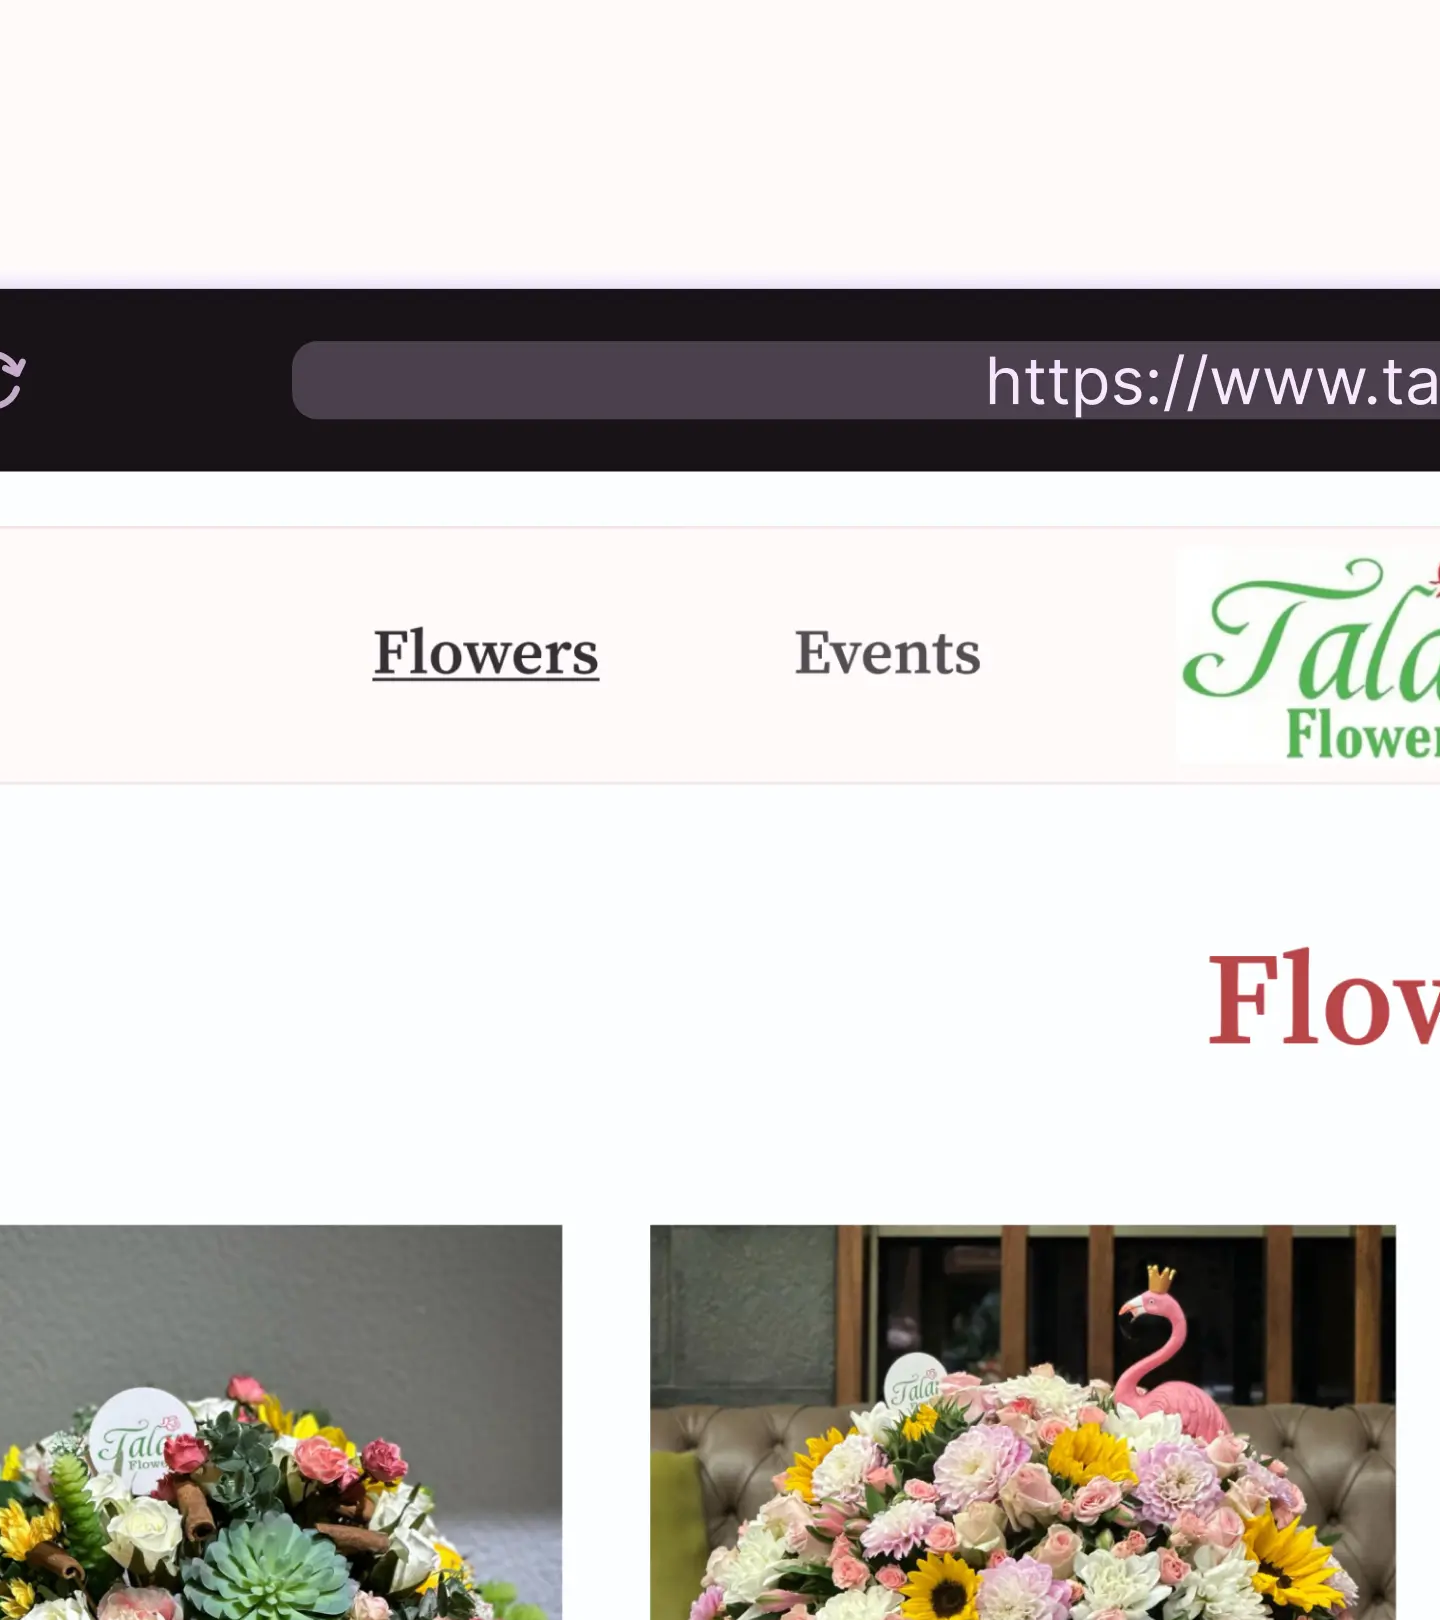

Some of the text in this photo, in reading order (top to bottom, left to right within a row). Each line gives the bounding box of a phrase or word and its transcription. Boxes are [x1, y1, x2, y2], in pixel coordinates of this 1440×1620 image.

[372, 626, 600, 677] Flowers
[795, 630, 980, 675] Events
[98, 1419, 167, 1460] Tala
